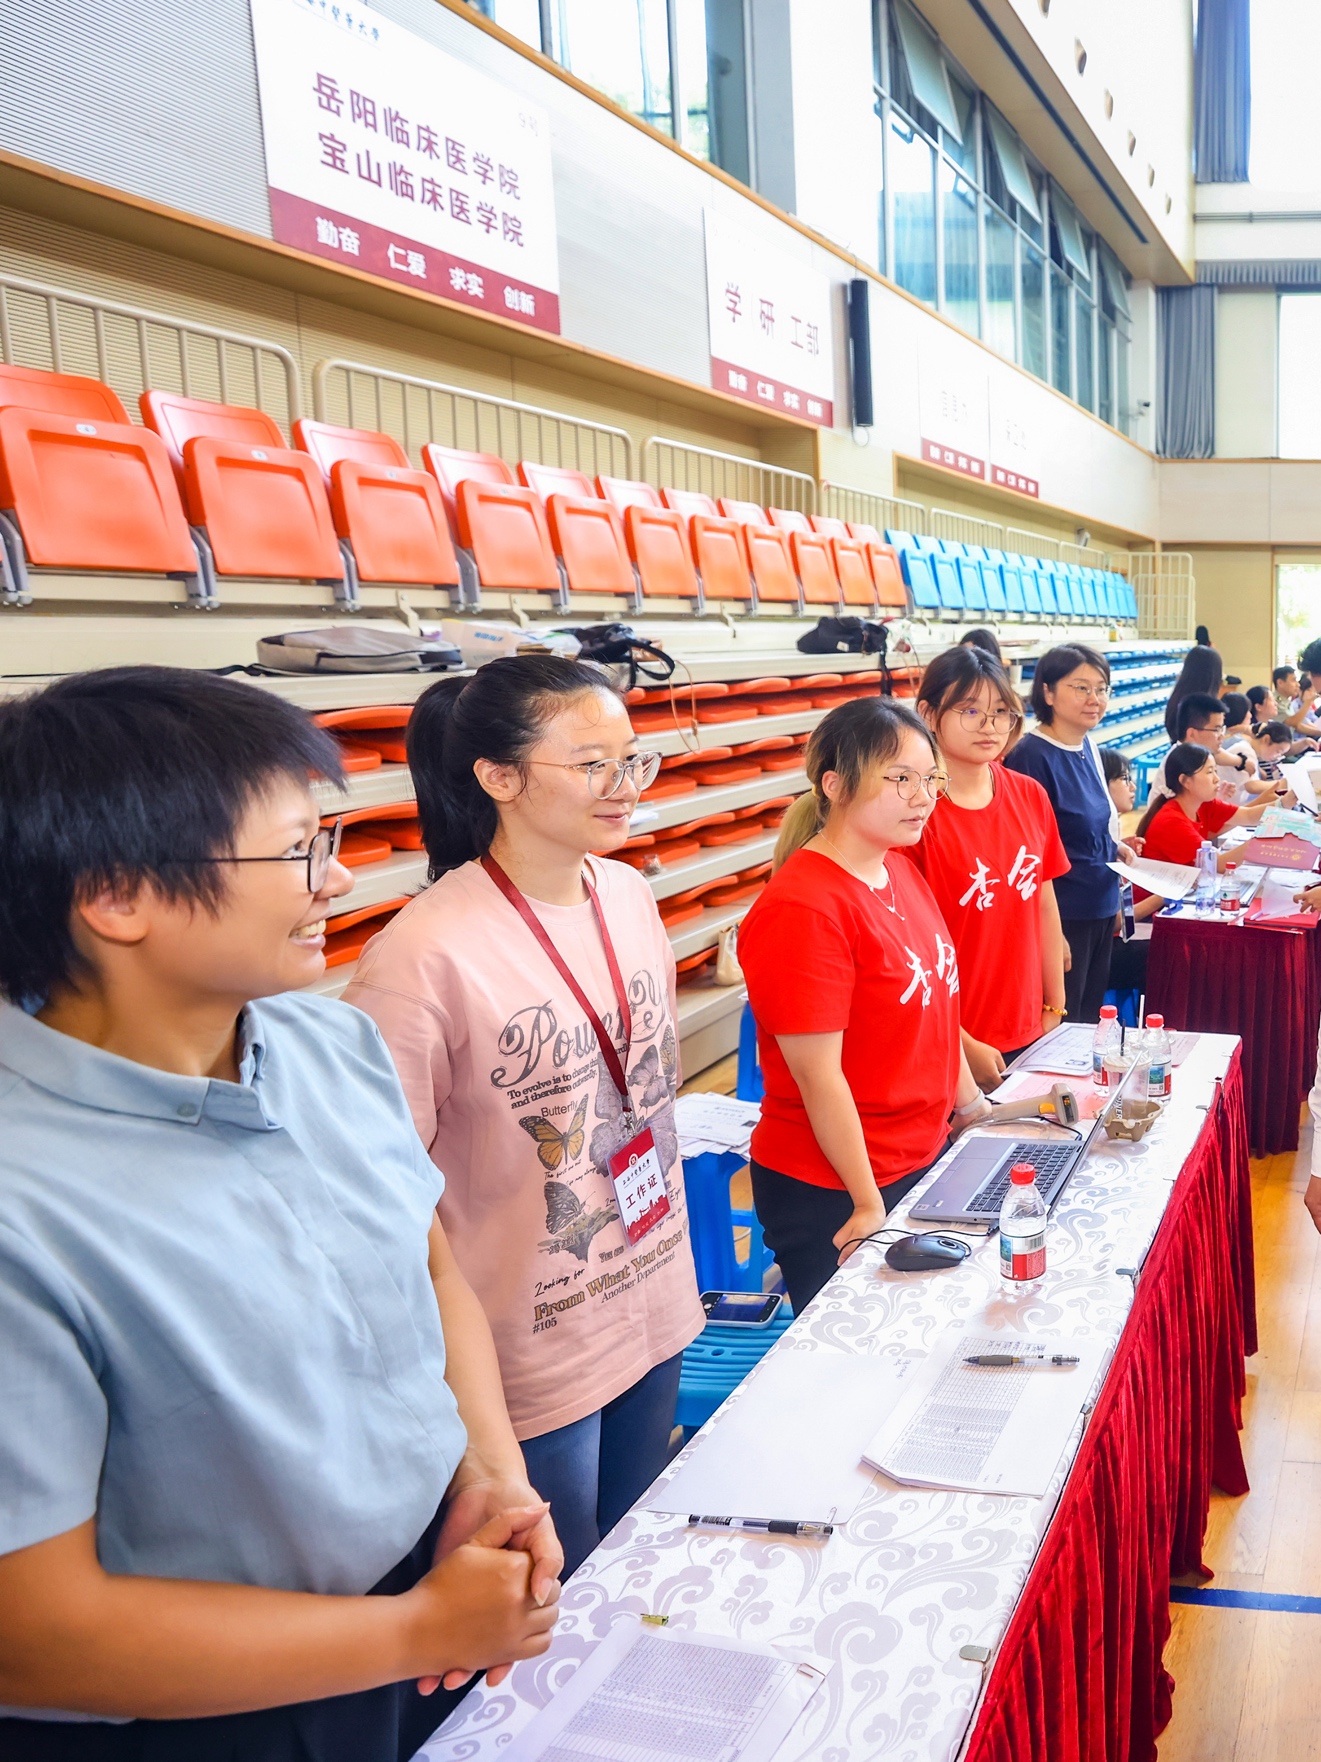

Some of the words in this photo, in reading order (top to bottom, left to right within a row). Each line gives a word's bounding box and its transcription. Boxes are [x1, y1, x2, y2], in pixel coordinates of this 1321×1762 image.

[313, 72, 521, 200] 岳阳临床医学院
[318, 132, 524, 247] 宝山临床医学院
[315, 216, 361, 256] 勤奋
[387, 243, 427, 279] 仁爱
[449, 266, 485, 299] 求实
[503, 286, 536, 316] 创新
[507, 1089, 522, 1100] To
[522, 1079, 552, 1095] evolve
[552, 1075, 562, 1085] is
[562, 1073, 572, 1082] to
[511, 1096, 530, 1110] and
[530, 1085, 572, 1103] therefore
[541, 1100, 578, 1117] Butterfly
[625, 1173, 658, 1209] 工作证
[534, 1291, 586, 1322] From
[586, 1264, 631, 1298] What
[631, 1250, 657, 1272] You
[656, 1230, 683, 1256] Once
[534, 1275, 571, 1298] Looking
[574, 1268, 585, 1281] for
[601, 1278, 637, 1303] Another
[637, 1251, 676, 1284] Department
[532, 1316, 558, 1334] #105
